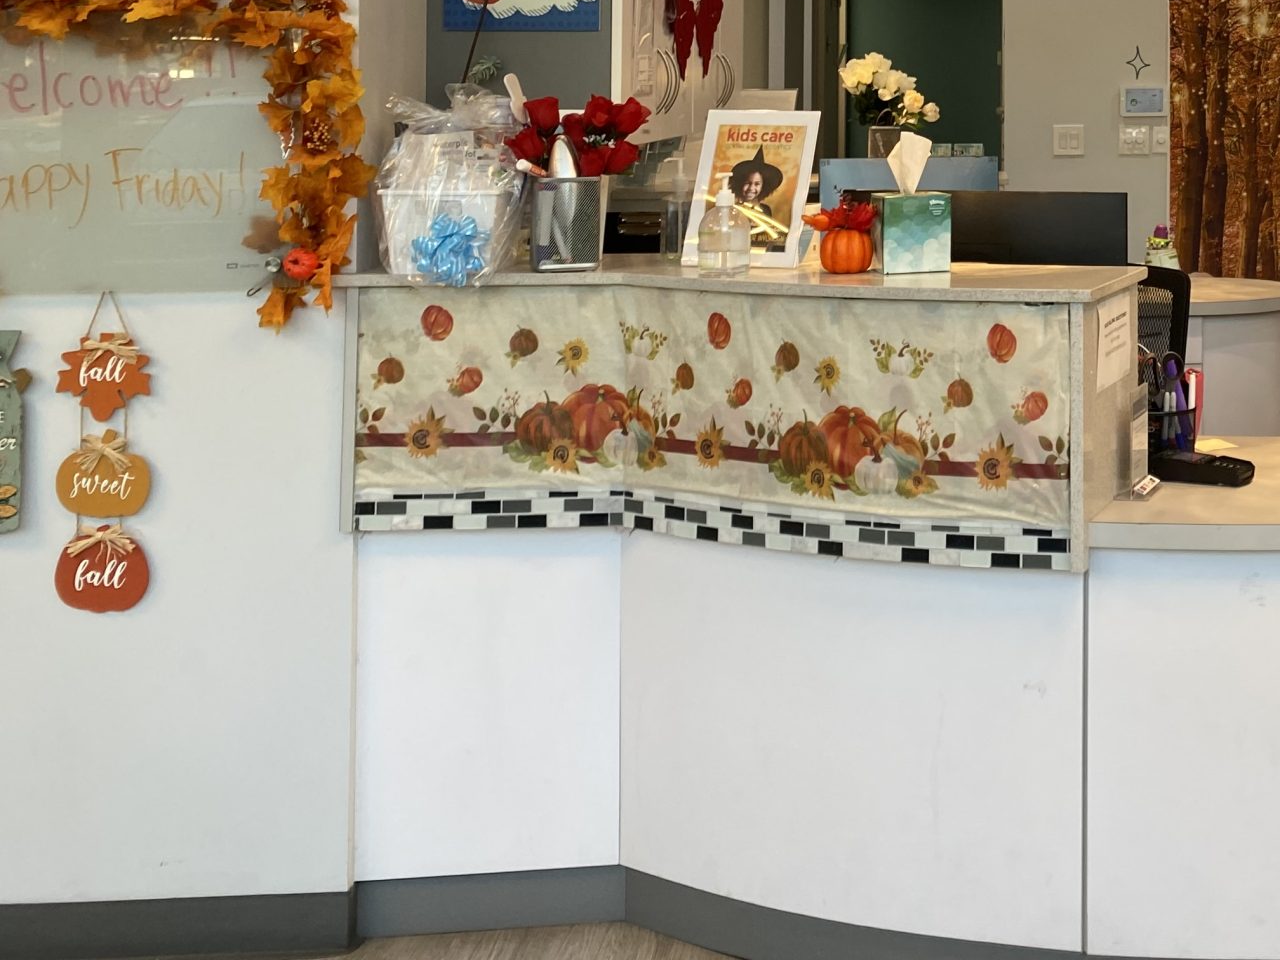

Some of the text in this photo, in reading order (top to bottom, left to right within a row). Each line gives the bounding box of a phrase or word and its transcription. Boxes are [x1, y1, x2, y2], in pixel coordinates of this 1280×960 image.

[0, 40, 183, 114] elcome
[727, 127, 794, 143] kids care
[0, 162, 90, 229] appy
[79, 355, 127, 387] fall
[70, 472, 135, 499] sweet
[74, 559, 126, 591] fall
